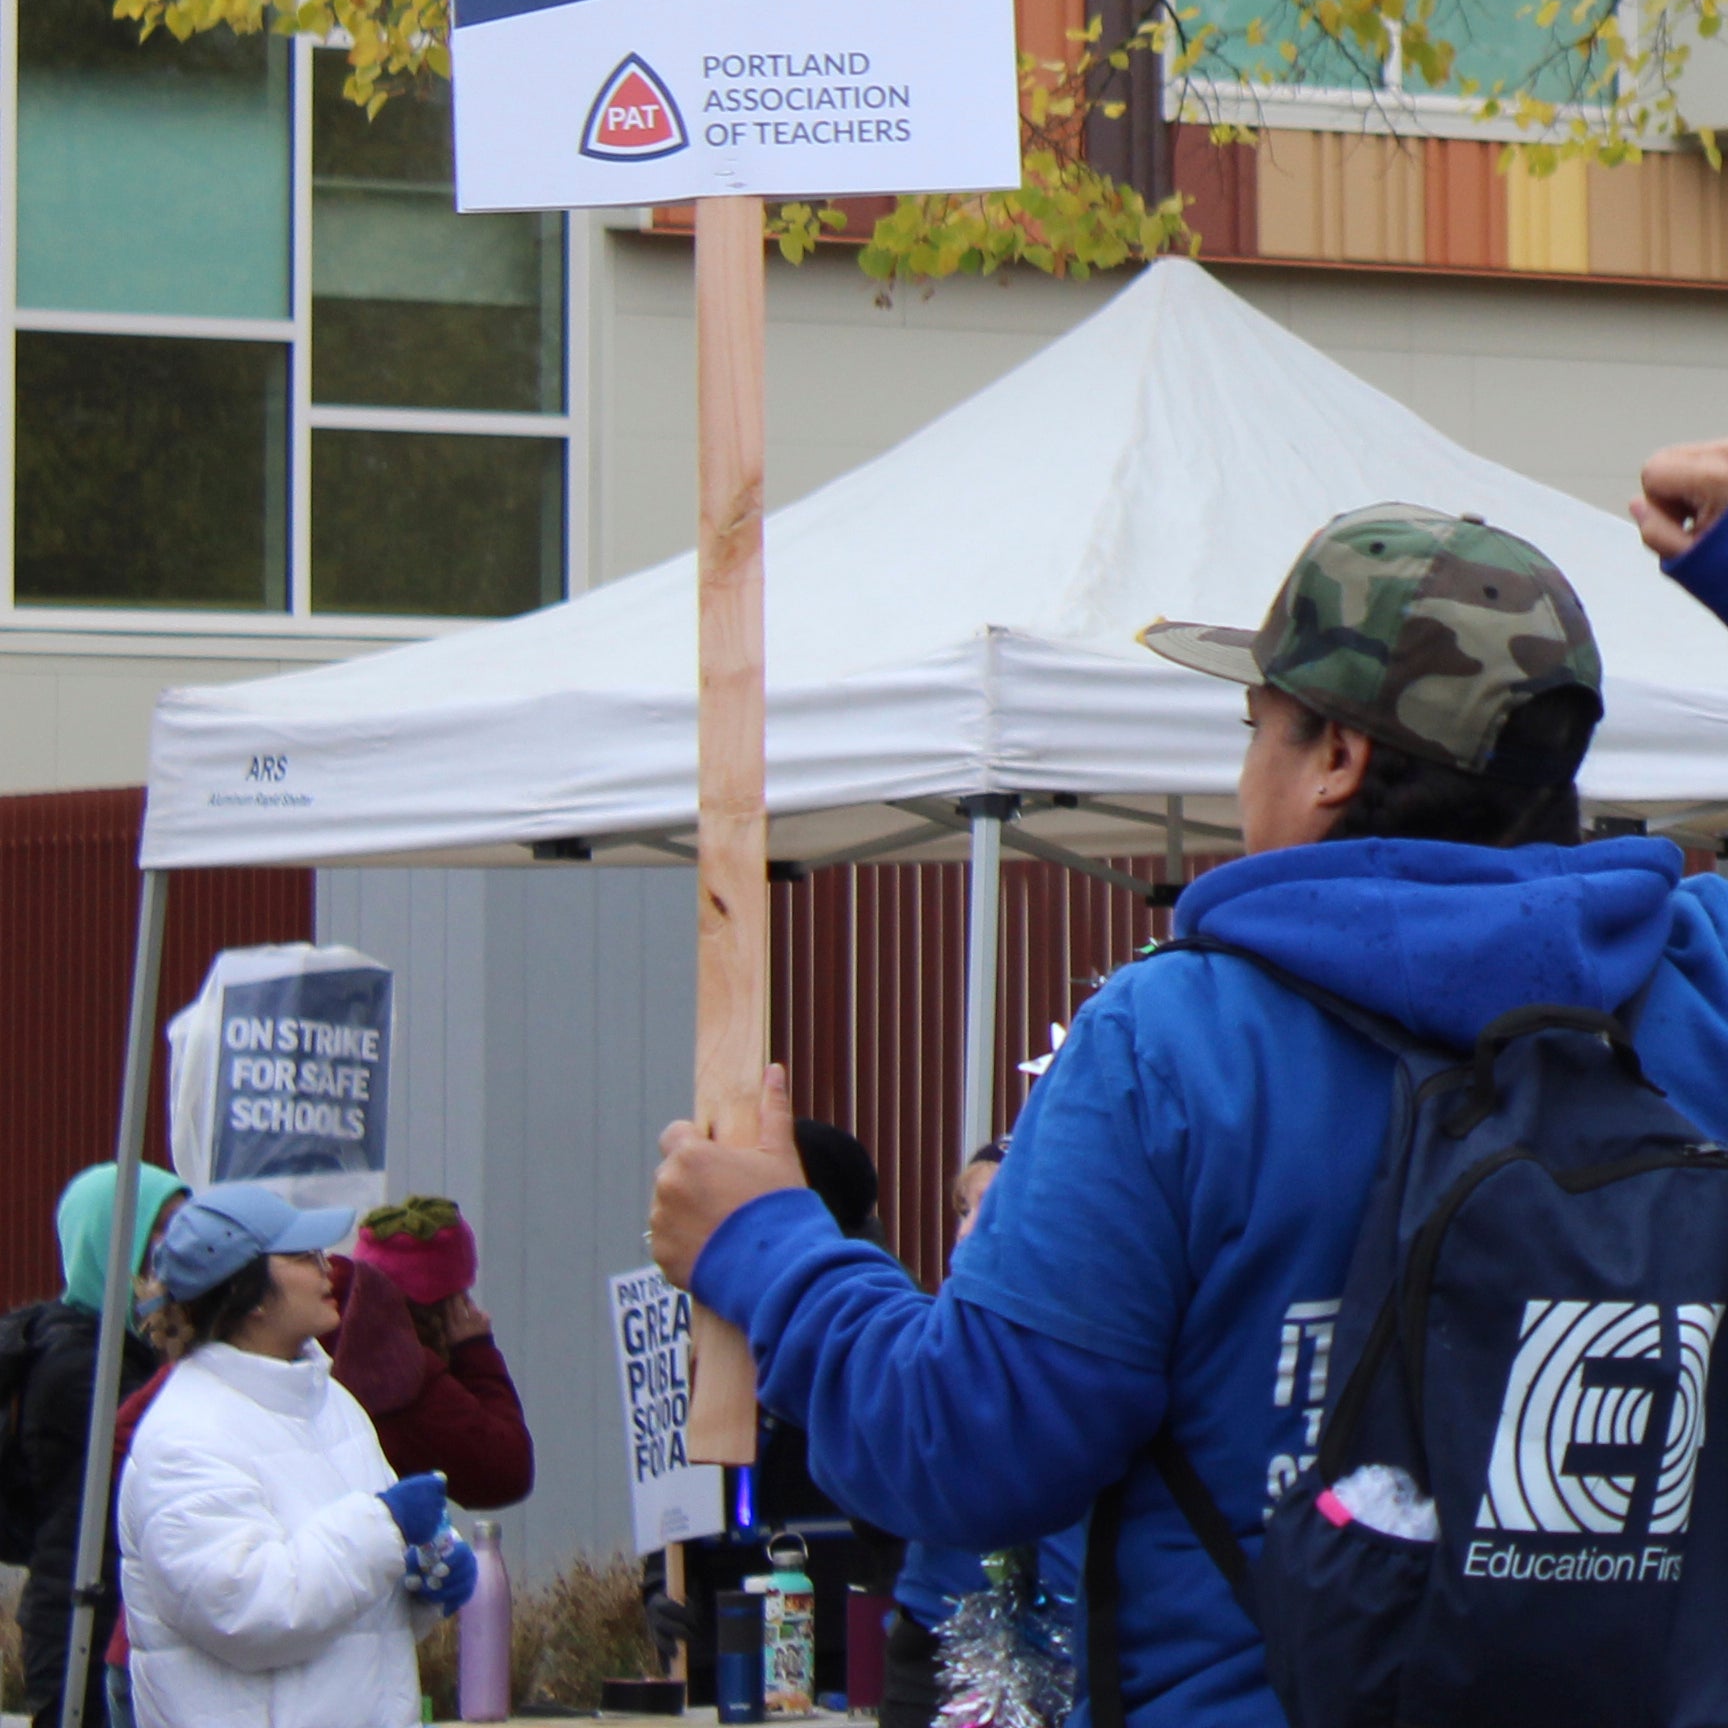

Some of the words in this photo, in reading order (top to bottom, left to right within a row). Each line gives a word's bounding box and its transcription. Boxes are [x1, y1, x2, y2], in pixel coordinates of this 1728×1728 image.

[703, 52, 871, 79] PORTLAND
[703, 84, 911, 113] ASSOCIATION
[607, 104, 660, 132] PAT
[705, 121, 748, 147] OF
[753, 118, 912, 145] TEACHERS
[245, 754, 288, 782] ARS
[226, 1017, 274, 1051] ON
[276, 1018, 380, 1062] STRIKE
[232, 1057, 296, 1092] FOR
[300, 1060, 370, 1101] SAFE
[231, 1097, 365, 1140] SCHOOLS
[1463, 1541, 1635, 1581] Education
